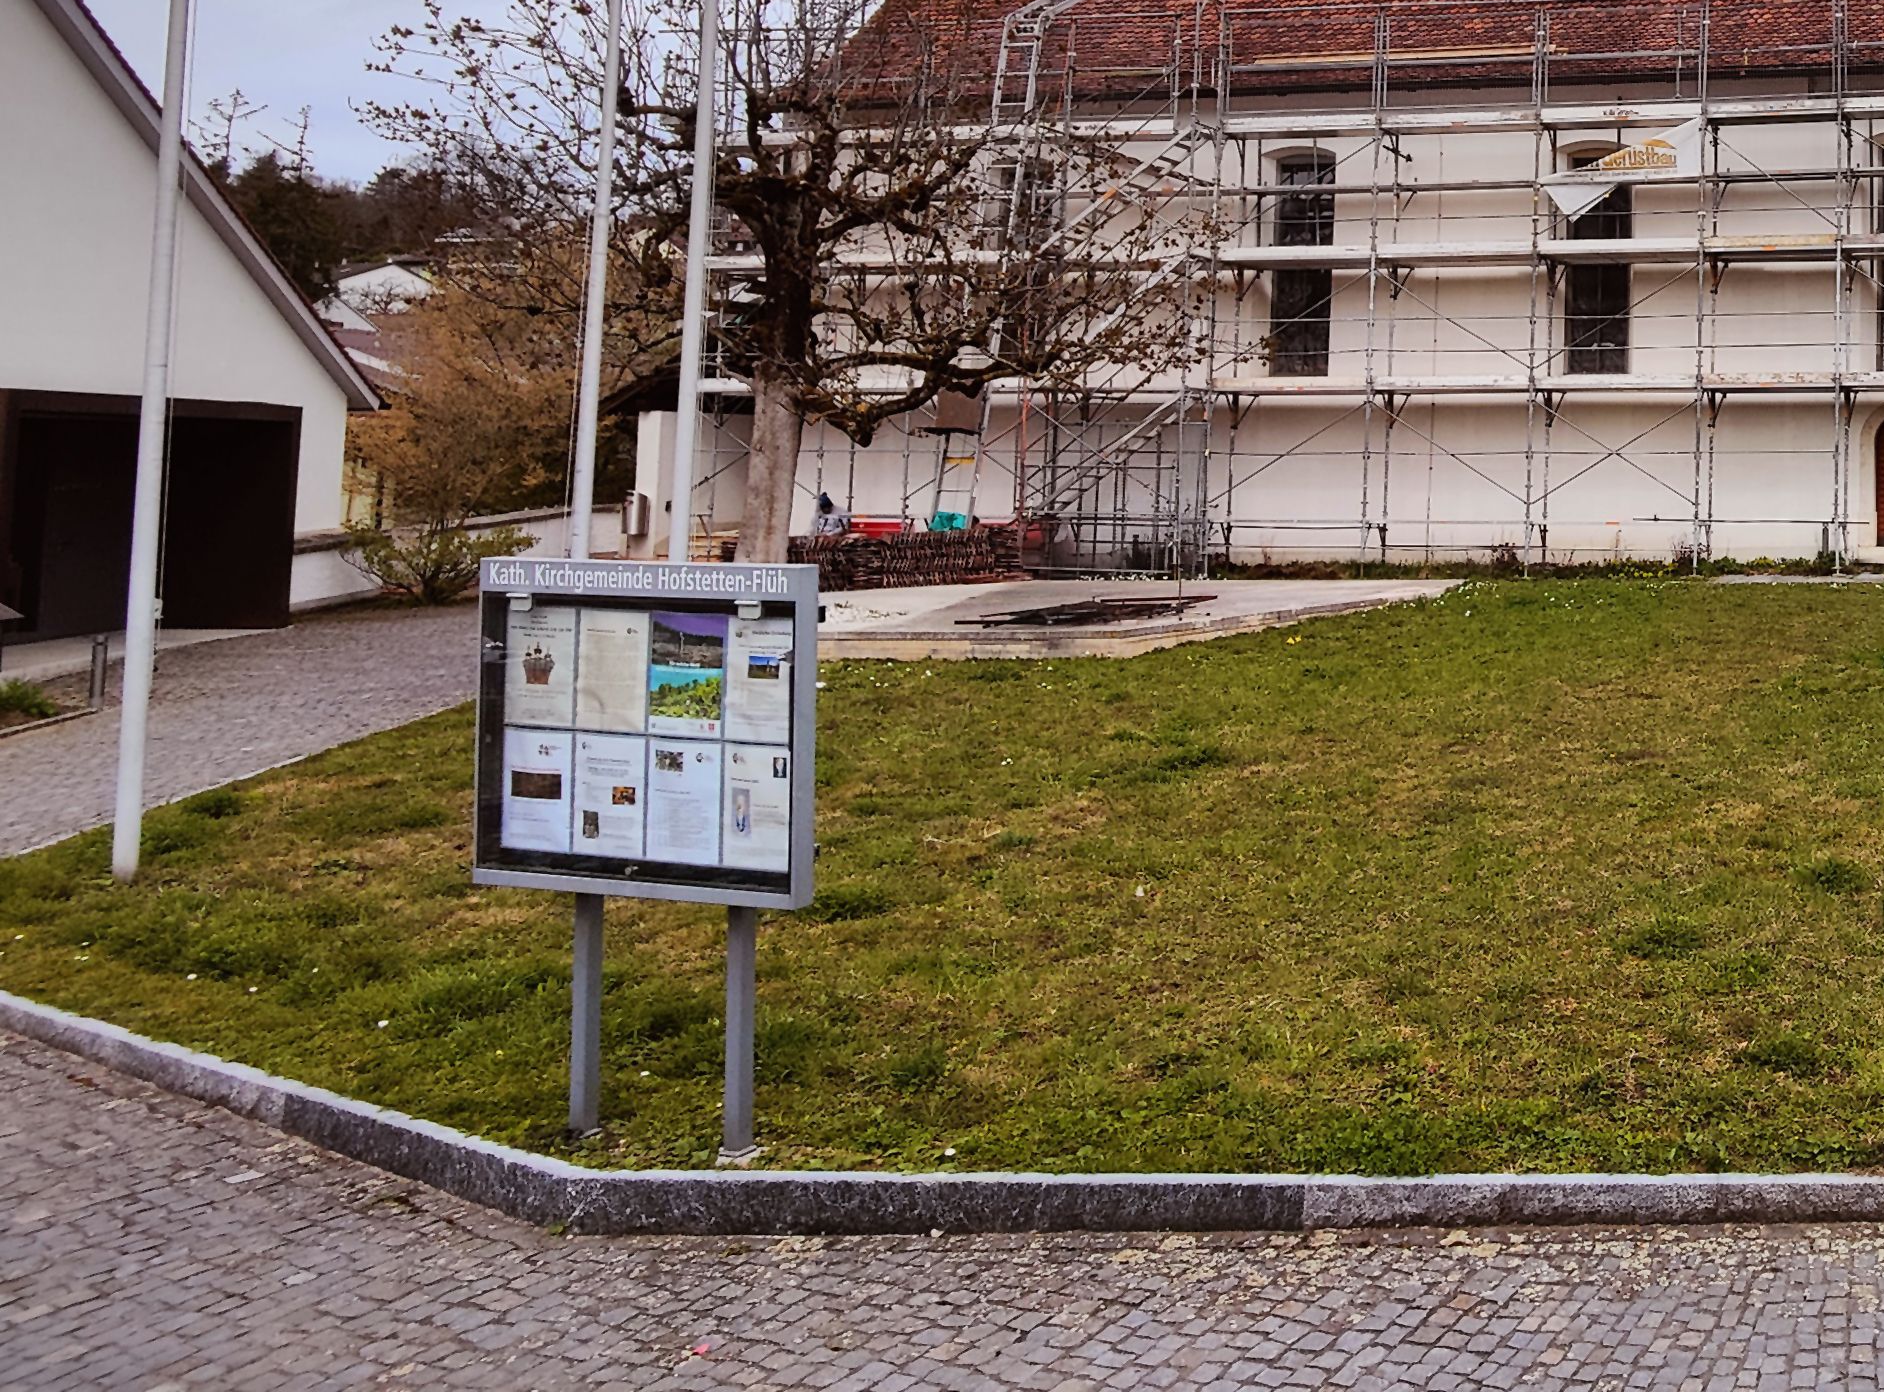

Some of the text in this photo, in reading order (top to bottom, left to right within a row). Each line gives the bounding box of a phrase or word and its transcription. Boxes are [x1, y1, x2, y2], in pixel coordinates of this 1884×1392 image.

[489, 563, 788, 593] Kath. Kirchgemeinde Hofstetten-Flüh
